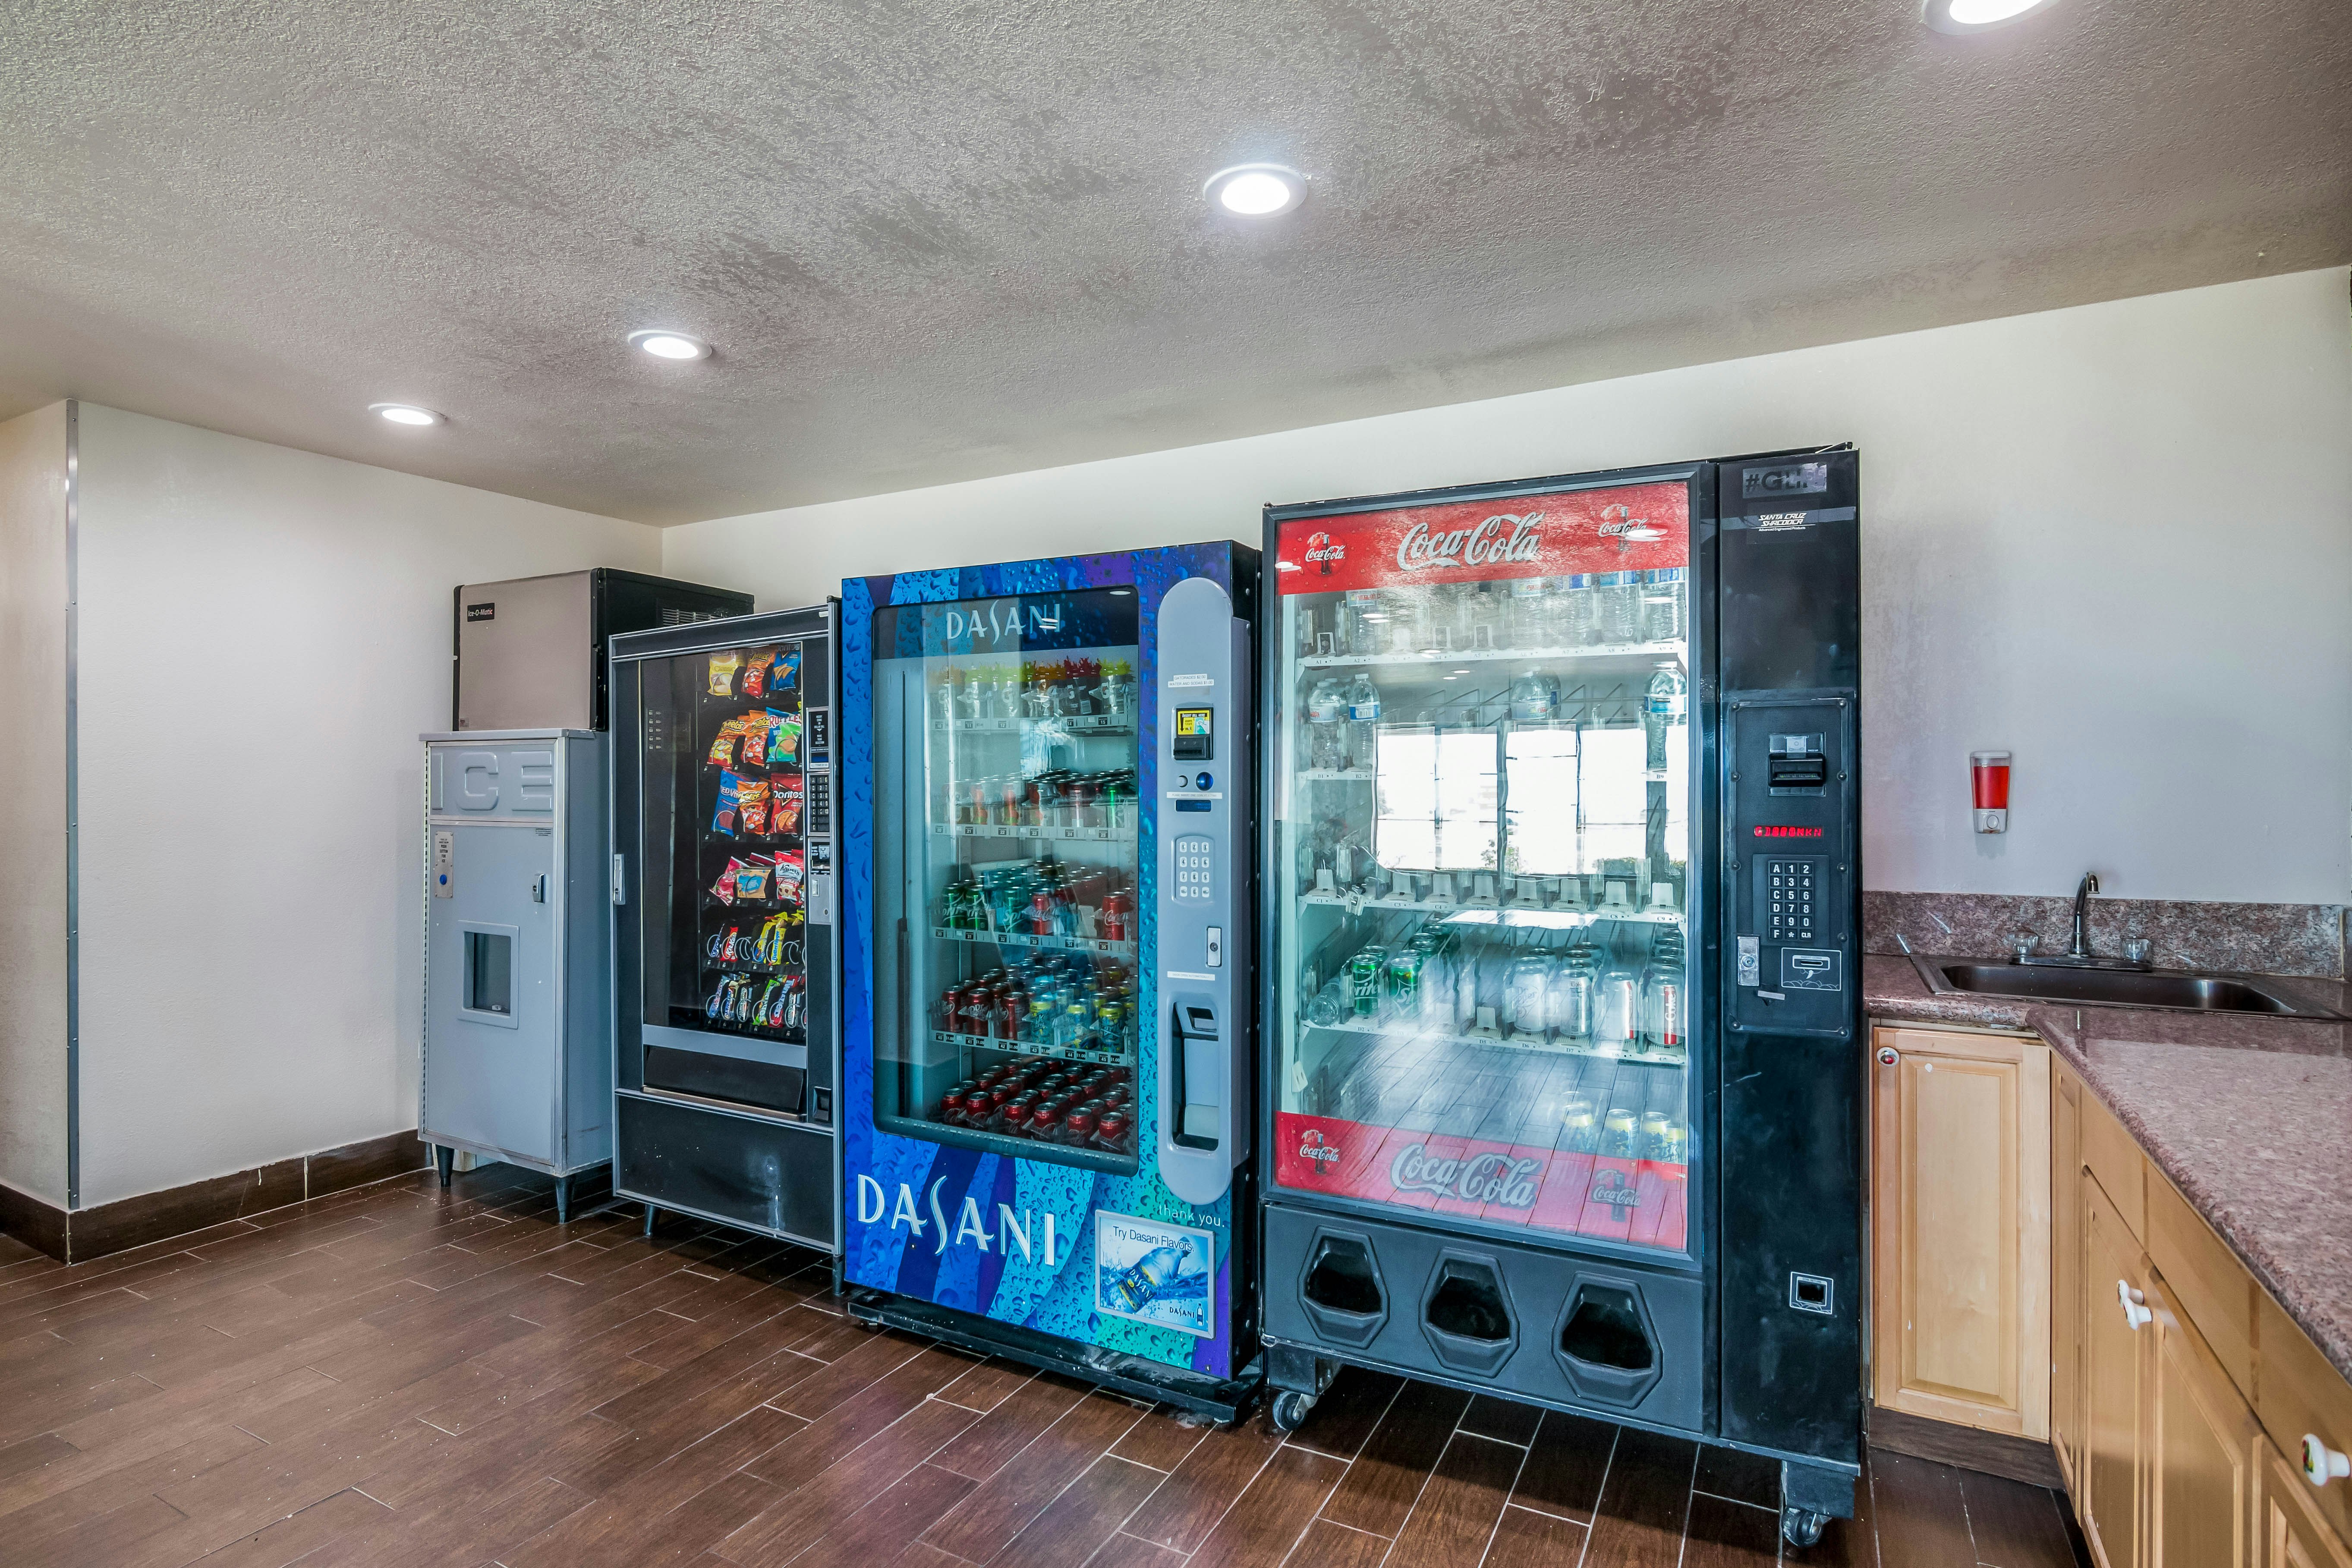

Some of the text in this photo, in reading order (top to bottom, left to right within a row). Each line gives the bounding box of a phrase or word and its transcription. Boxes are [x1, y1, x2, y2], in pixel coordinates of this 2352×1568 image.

[1397, 511, 1546, 572] Coca-Cola
[1305, 545, 1346, 562] Coca-Cola
[468, 608, 493, 617] Ice-O-Matic
[947, 599, 1060, 645] DASANI
[721, 721, 744, 732] Cheetos
[431, 750, 553, 811] ICE
[774, 790, 803, 799] Doritos
[1803, 865, 1809, 873] 2
[1788, 878, 1794, 886] 3
[1803, 878, 1809, 887] 4
[1773, 891, 1809, 900] C 5 6
[1773, 904, 1809, 913] D 7 8
[1774, 917, 1809, 926] E 9 0
[1774, 930, 1779, 938] F
[1665, 993, 1676, 1021] Coke
[1300, 1144, 1340, 1162] Coca-Cola
[1392, 1143, 1539, 1207] Coca-Cola
[1593, 1186, 1642, 1206] Coca-Cola
[858, 1174, 1055, 1266] DASANI
[1159, 1204, 1225, 1228] thank you.
[1113, 1226, 1194, 1252] Try Dasani Flavors.
[1129, 1269, 1153, 1300] DASANI
[1169, 1307, 1194, 1318] DASANI
